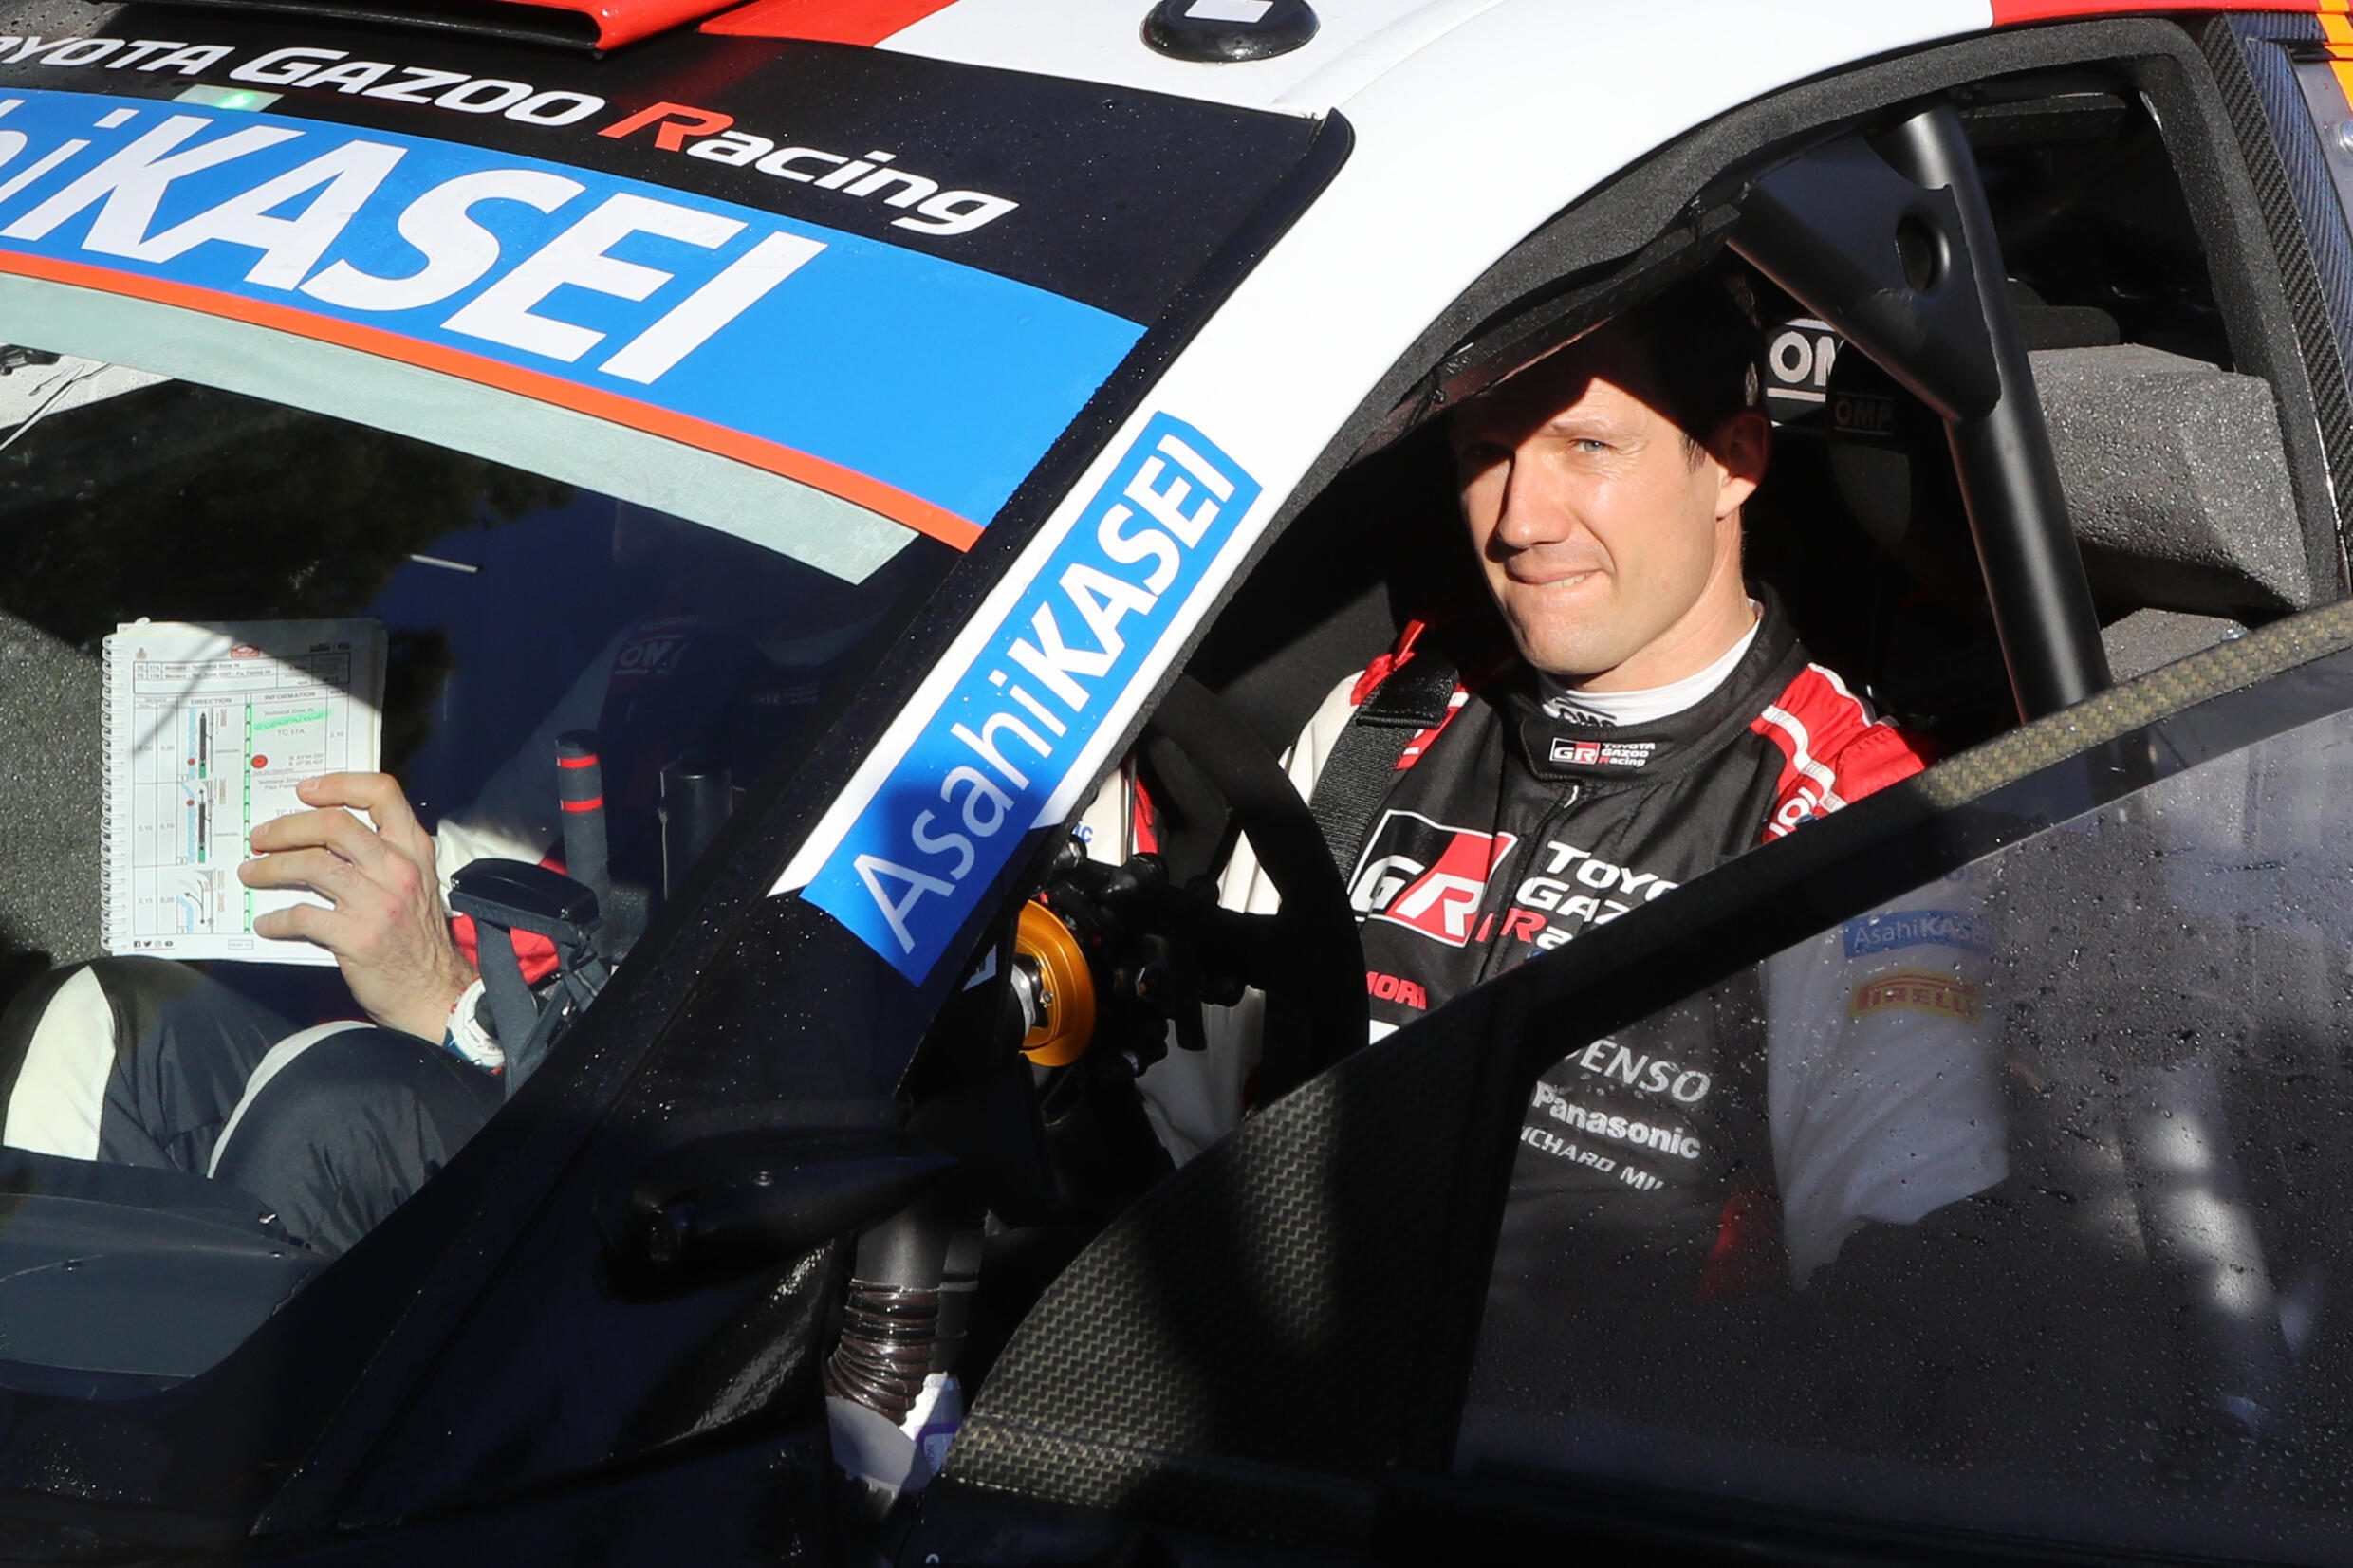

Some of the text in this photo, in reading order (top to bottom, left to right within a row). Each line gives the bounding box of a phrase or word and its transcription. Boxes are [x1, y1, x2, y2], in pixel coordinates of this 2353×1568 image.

[0, 35, 1021, 236] YOTA GAZOO Racing
[1769, 331, 1845, 387] OM
[264, 691, 316, 701] INFORMATION
[852, 434, 1236, 955] AsahiKASEI
[1553, 747, 1598, 763] GR
[1598, 757, 1646, 768] Racing
[1601, 749, 1649, 758] GAZOO
[1602, 742, 1656, 750] TOYOTA
[1349, 855, 1486, 938] GR
[1566, 1039, 1711, 1103] ENSO
[1532, 1080, 1702, 1160] Panasonic
[1520, 1126, 1617, 1173] ICHARD
